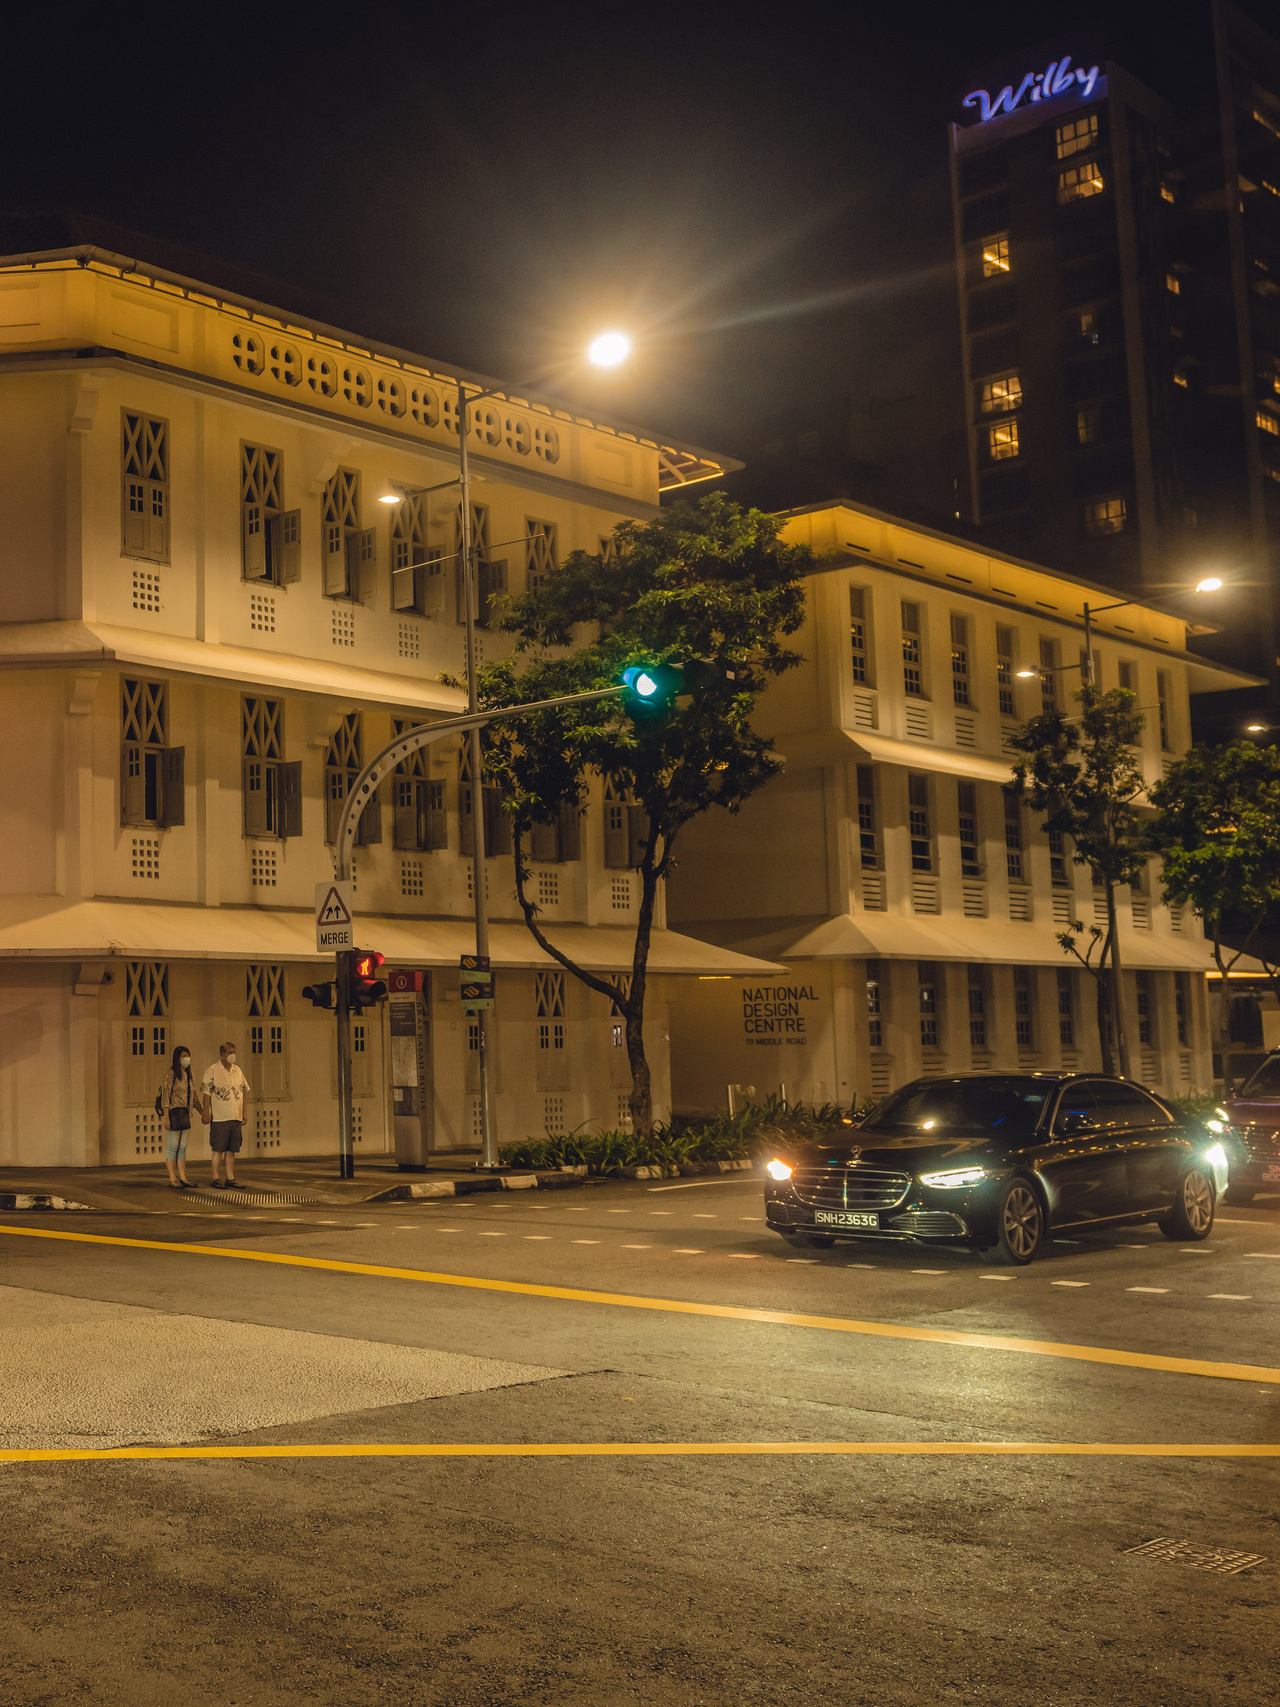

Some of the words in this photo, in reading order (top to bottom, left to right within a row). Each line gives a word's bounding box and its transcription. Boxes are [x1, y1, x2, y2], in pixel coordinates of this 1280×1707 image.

[962, 55, 1100, 122] Wilby
[320, 931, 349, 945] MERGE
[742, 986, 819, 1002] NATIONAL
[743, 1002, 799, 1018] DESIGN
[744, 1017, 806, 1033] CENTRE
[756, 1038, 783, 1046] MIDDLE
[786, 1037, 807, 1045] ROAD
[817, 1212, 878, 1227] SNH2363G
